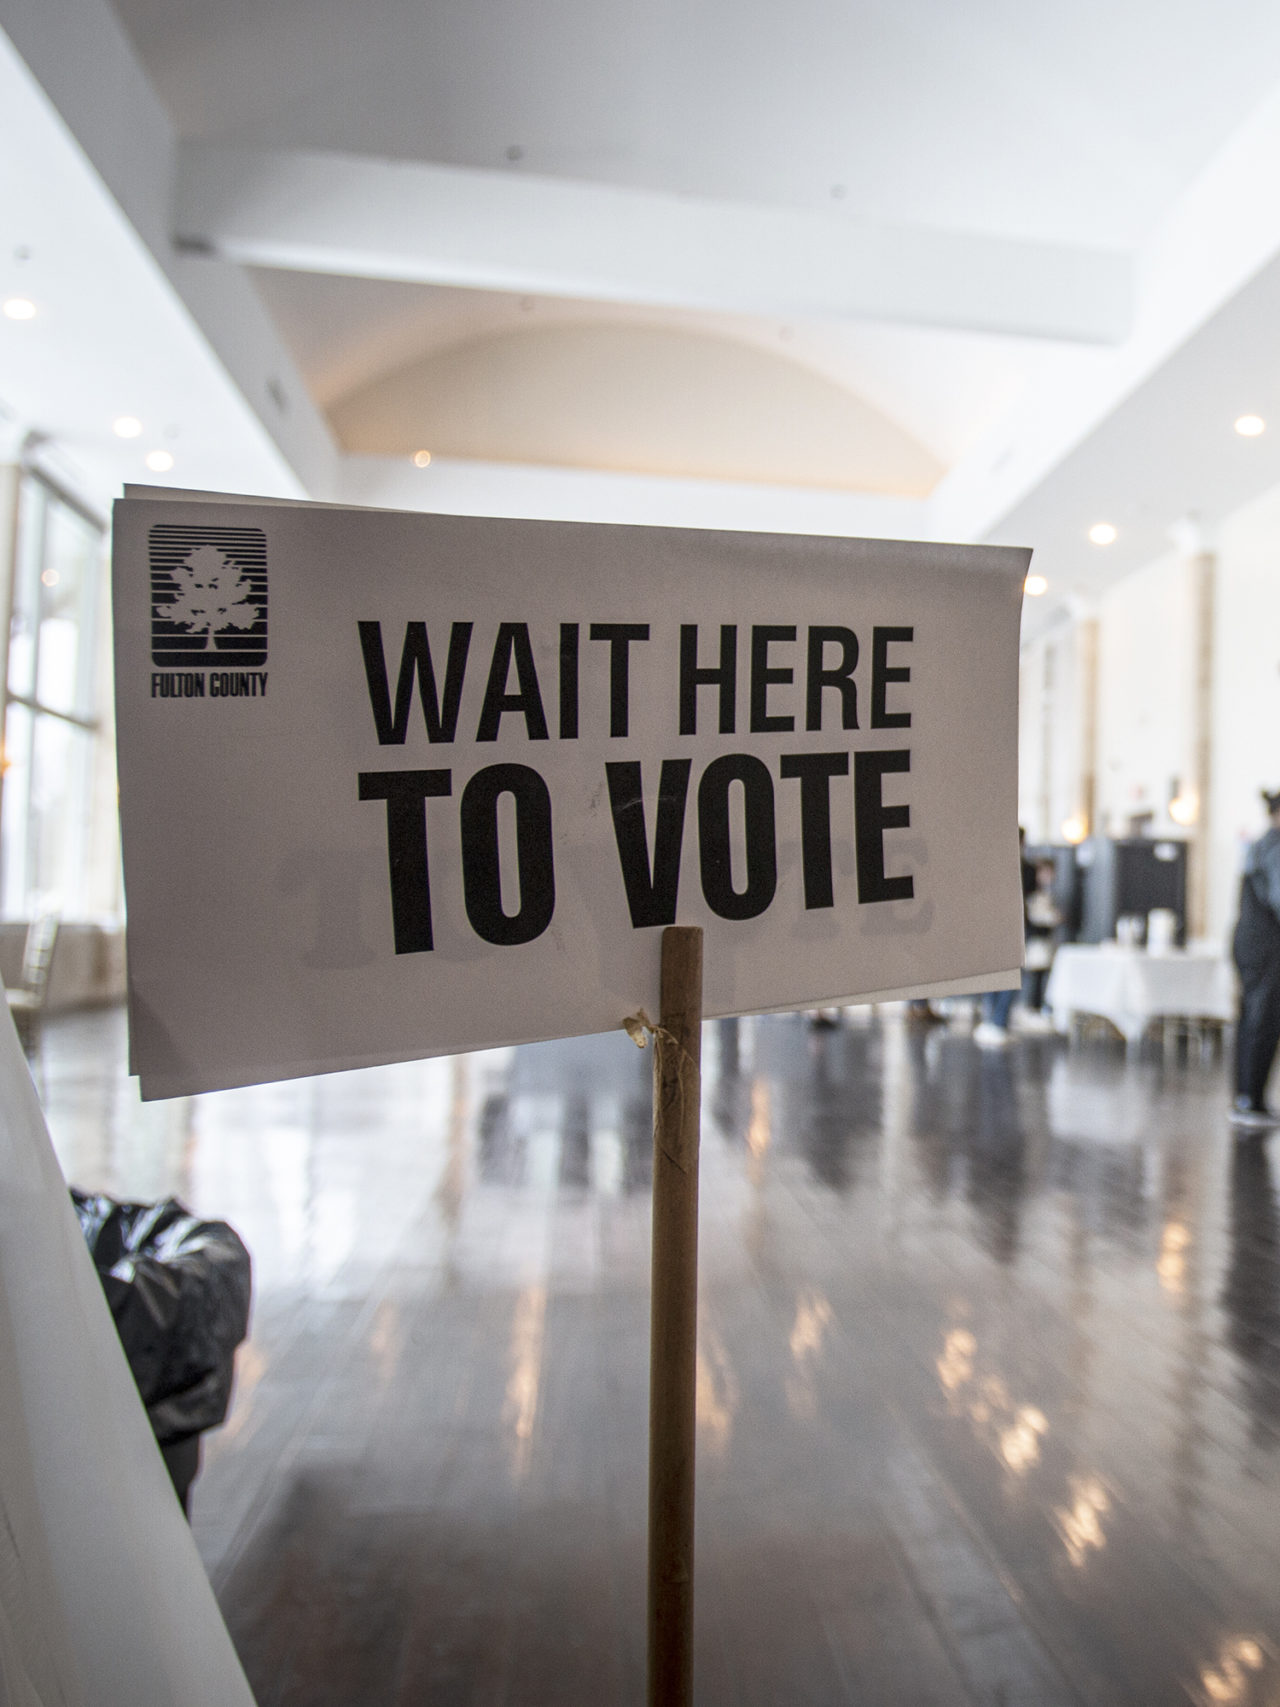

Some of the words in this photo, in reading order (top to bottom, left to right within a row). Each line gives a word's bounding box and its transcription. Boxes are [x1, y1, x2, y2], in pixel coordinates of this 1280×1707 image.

[151, 672, 206, 699] FULTON
[209, 671, 269, 698] COUNTY
[357, 620, 651, 746] WAIT
[679, 624, 915, 738] HERE
[357, 761, 557, 956] TO
[604, 748, 915, 930] VOTE
